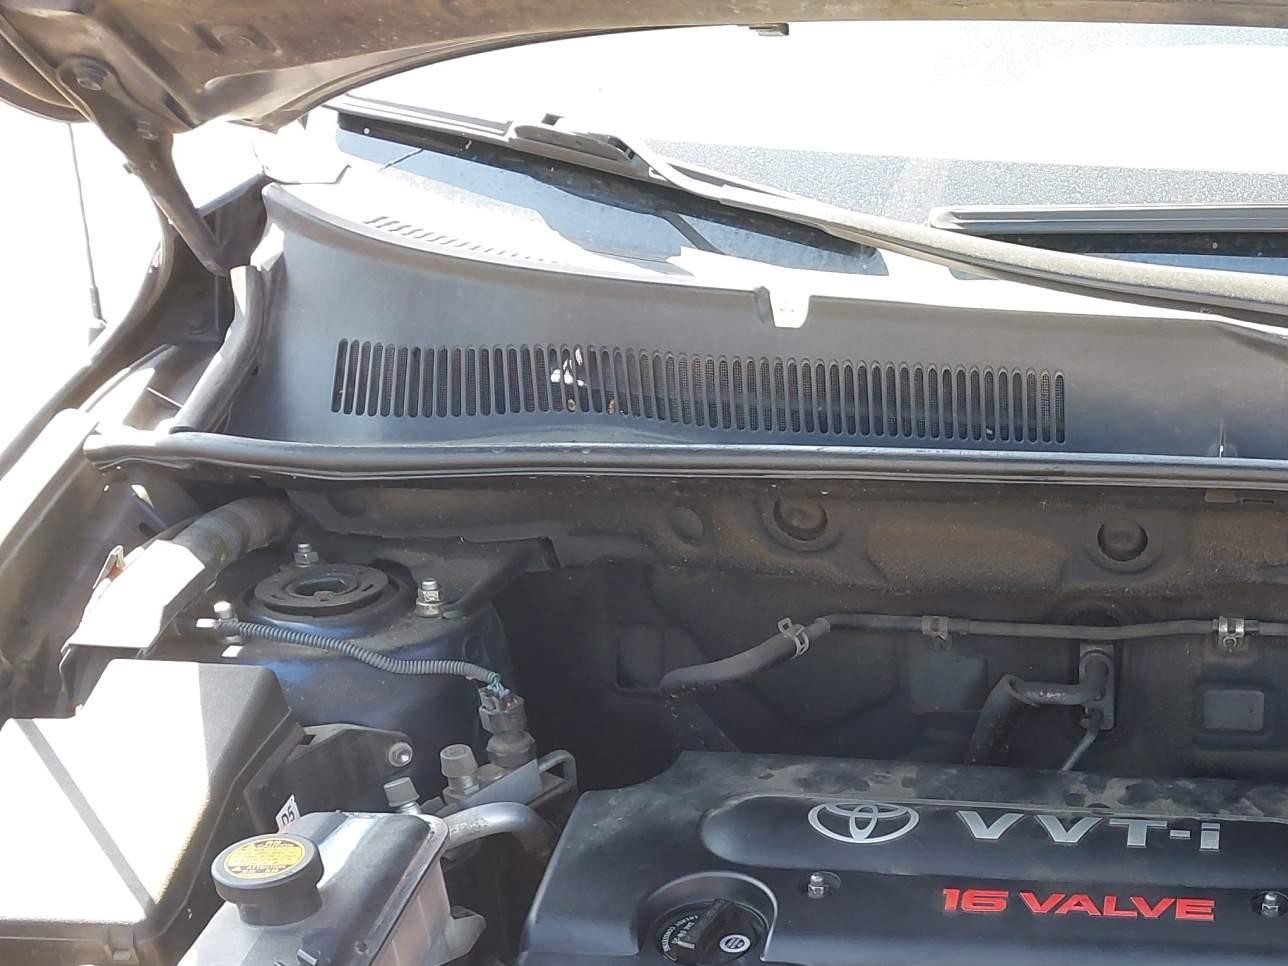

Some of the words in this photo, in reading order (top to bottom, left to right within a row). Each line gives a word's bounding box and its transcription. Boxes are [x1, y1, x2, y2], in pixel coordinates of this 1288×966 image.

[956, 810, 1221, 851] VVT-i
[943, 888, 1009, 913] 16
[1020, 892, 1216, 921] VALVE
